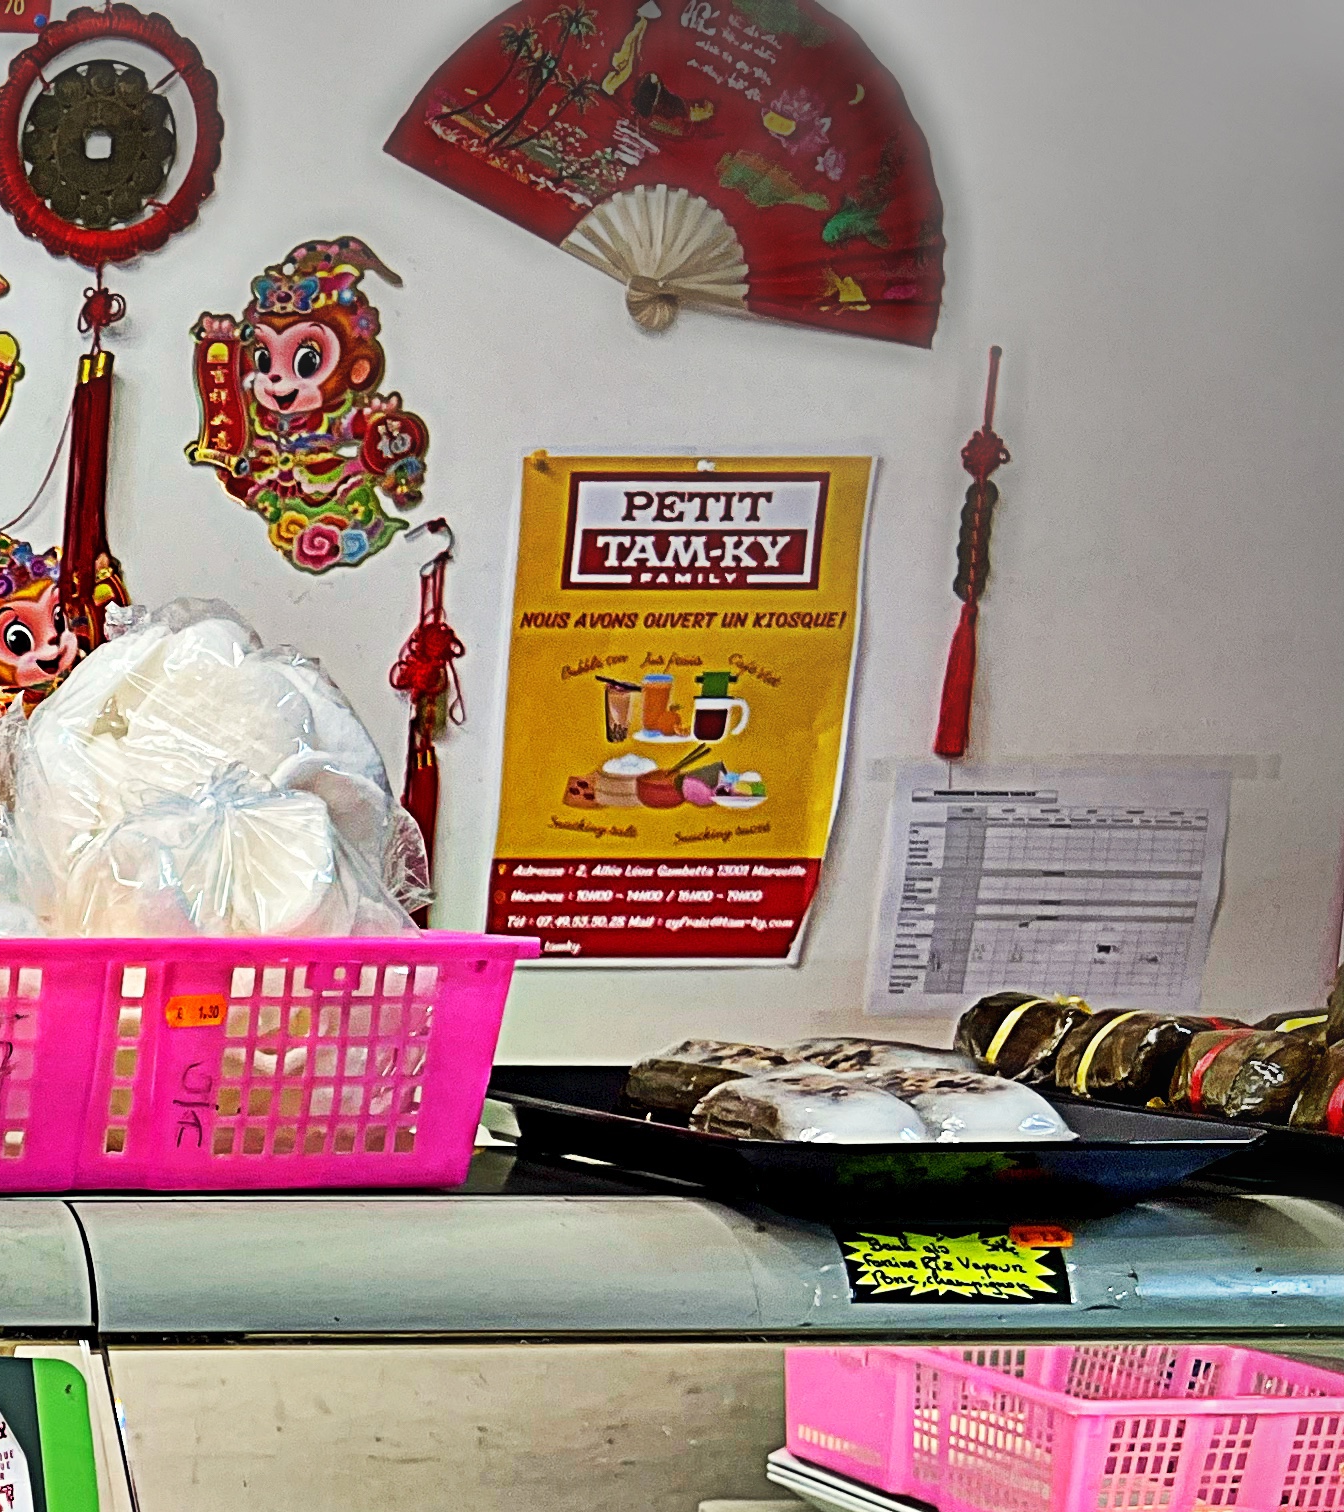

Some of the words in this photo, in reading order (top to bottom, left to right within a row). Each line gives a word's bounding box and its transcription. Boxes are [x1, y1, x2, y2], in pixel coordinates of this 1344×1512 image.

[621, 491, 773, 522] PETIT
[596, 536, 791, 567] TAM-KY
[640, 573, 737, 583] FAMILY
[520, 612, 571, 629] NOUS
[574, 612, 638, 629] AVONS
[644, 612, 718, 629] OUVERT
[721, 612, 747, 629] UN
